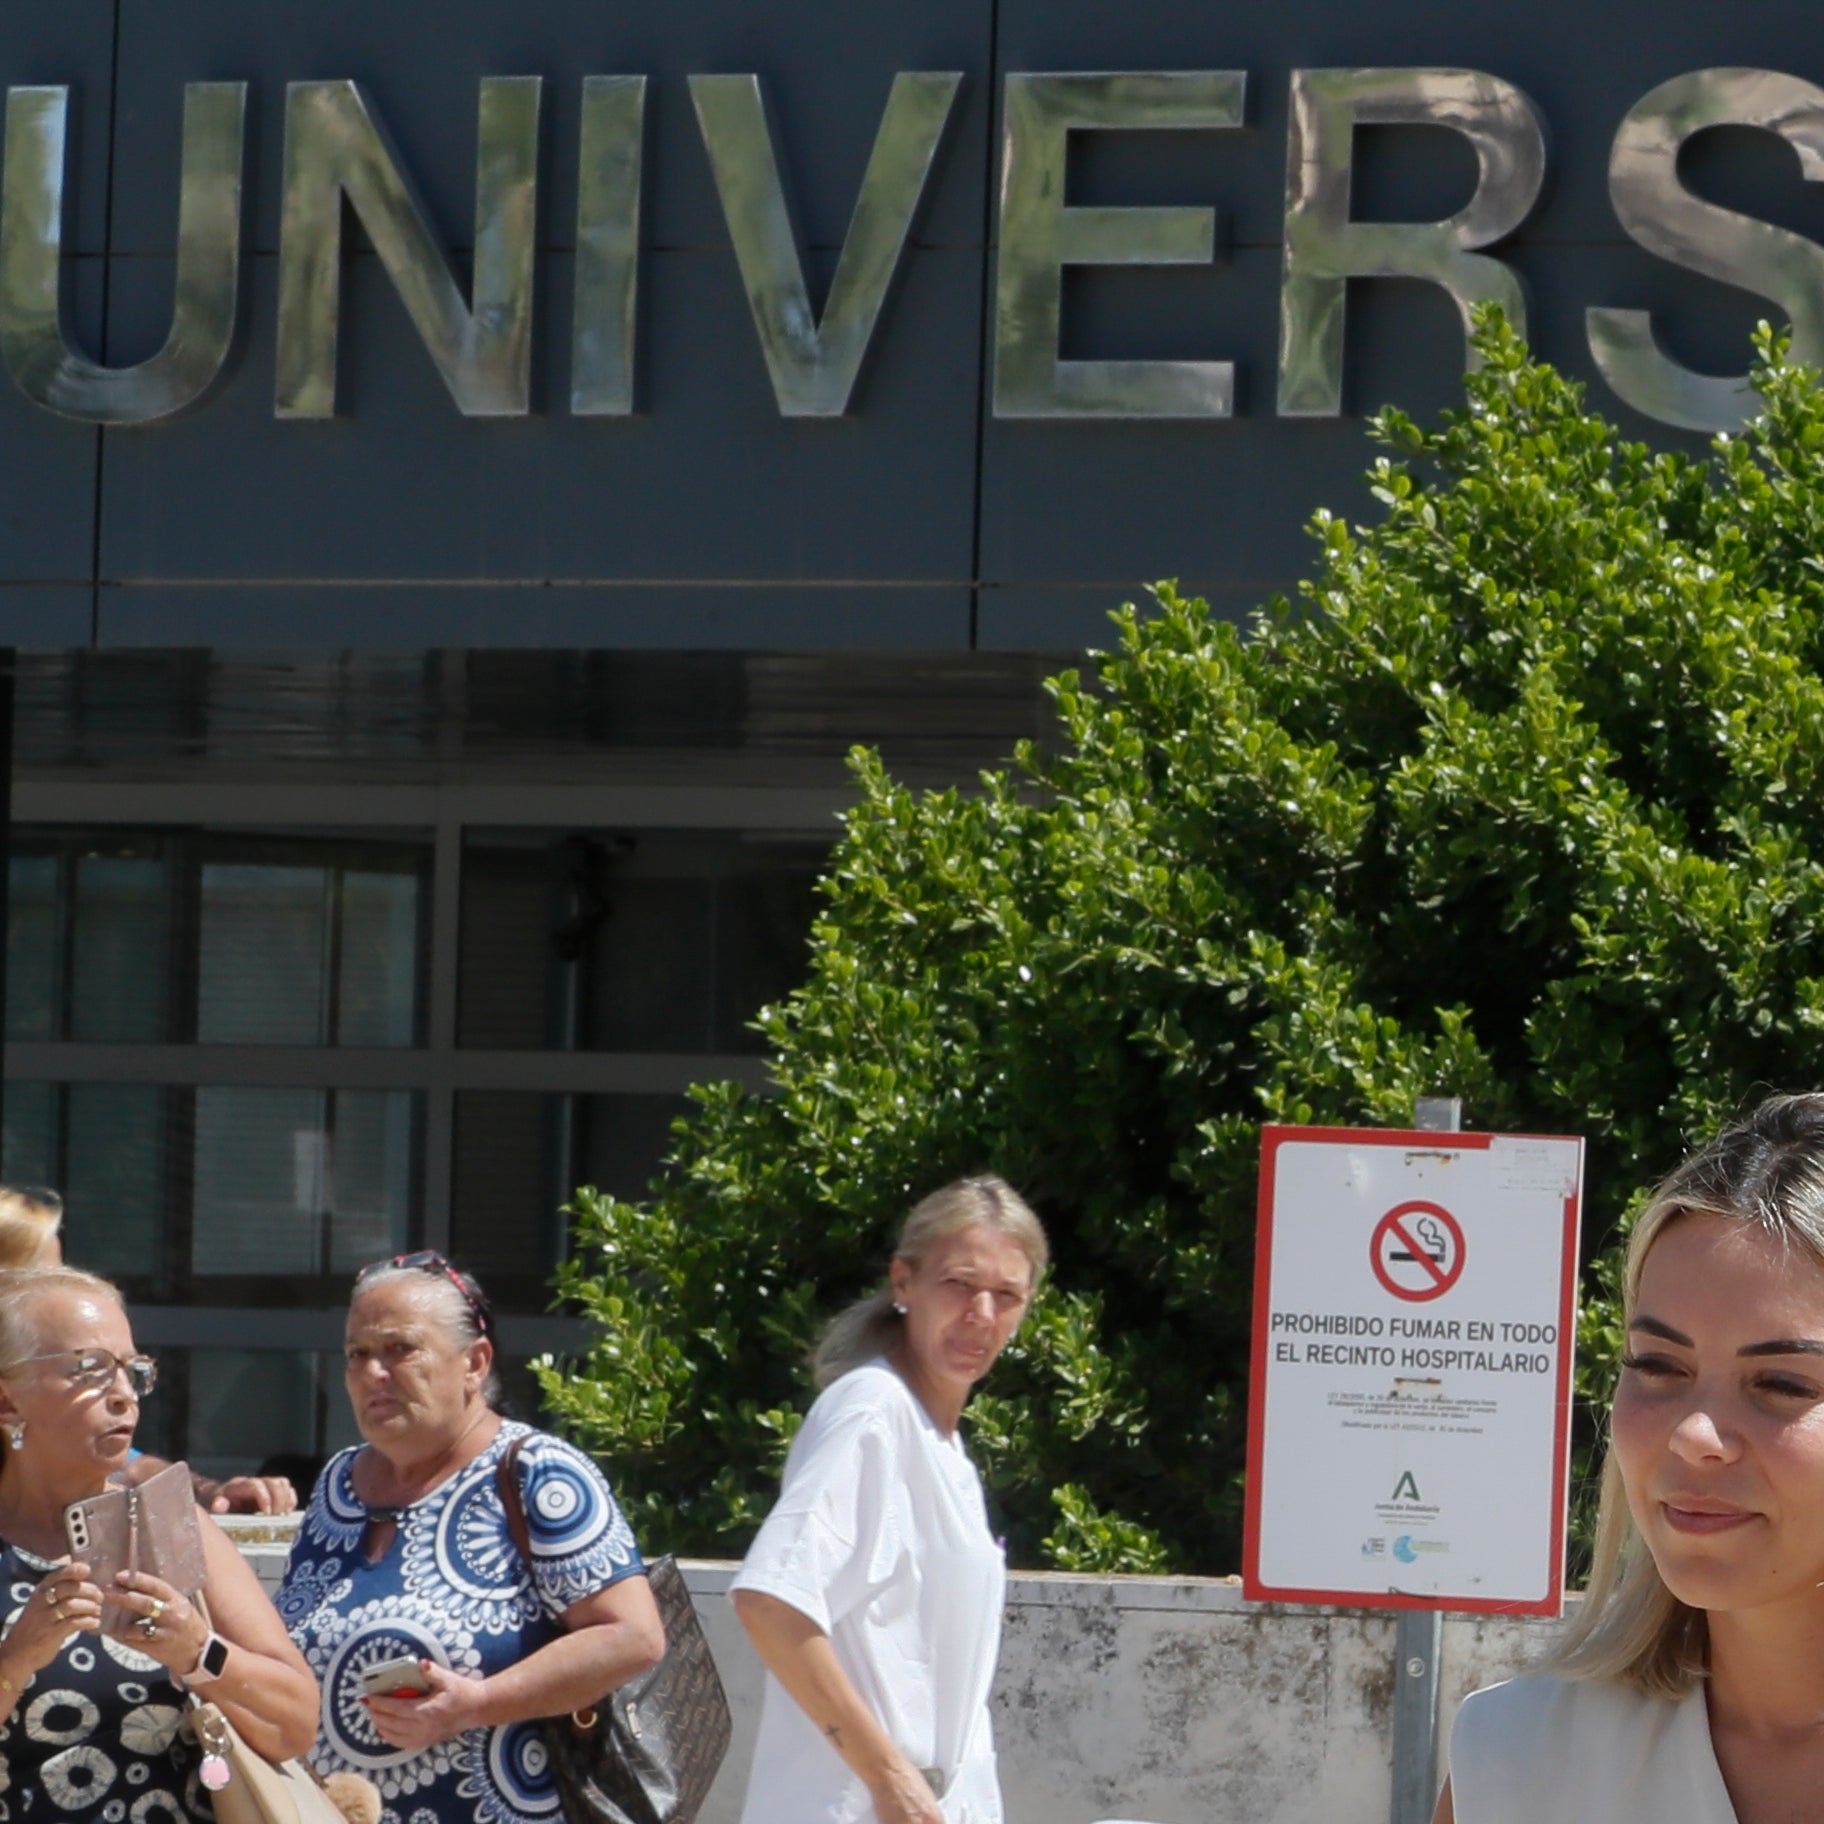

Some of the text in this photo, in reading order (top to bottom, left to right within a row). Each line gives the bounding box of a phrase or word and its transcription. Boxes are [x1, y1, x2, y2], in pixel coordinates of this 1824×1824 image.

[1271, 1313, 1557, 1345] PROHIBIDO FUMAR EN TODO
[1275, 1342, 1550, 1374] EL RECINTO HOSPITALARIO
